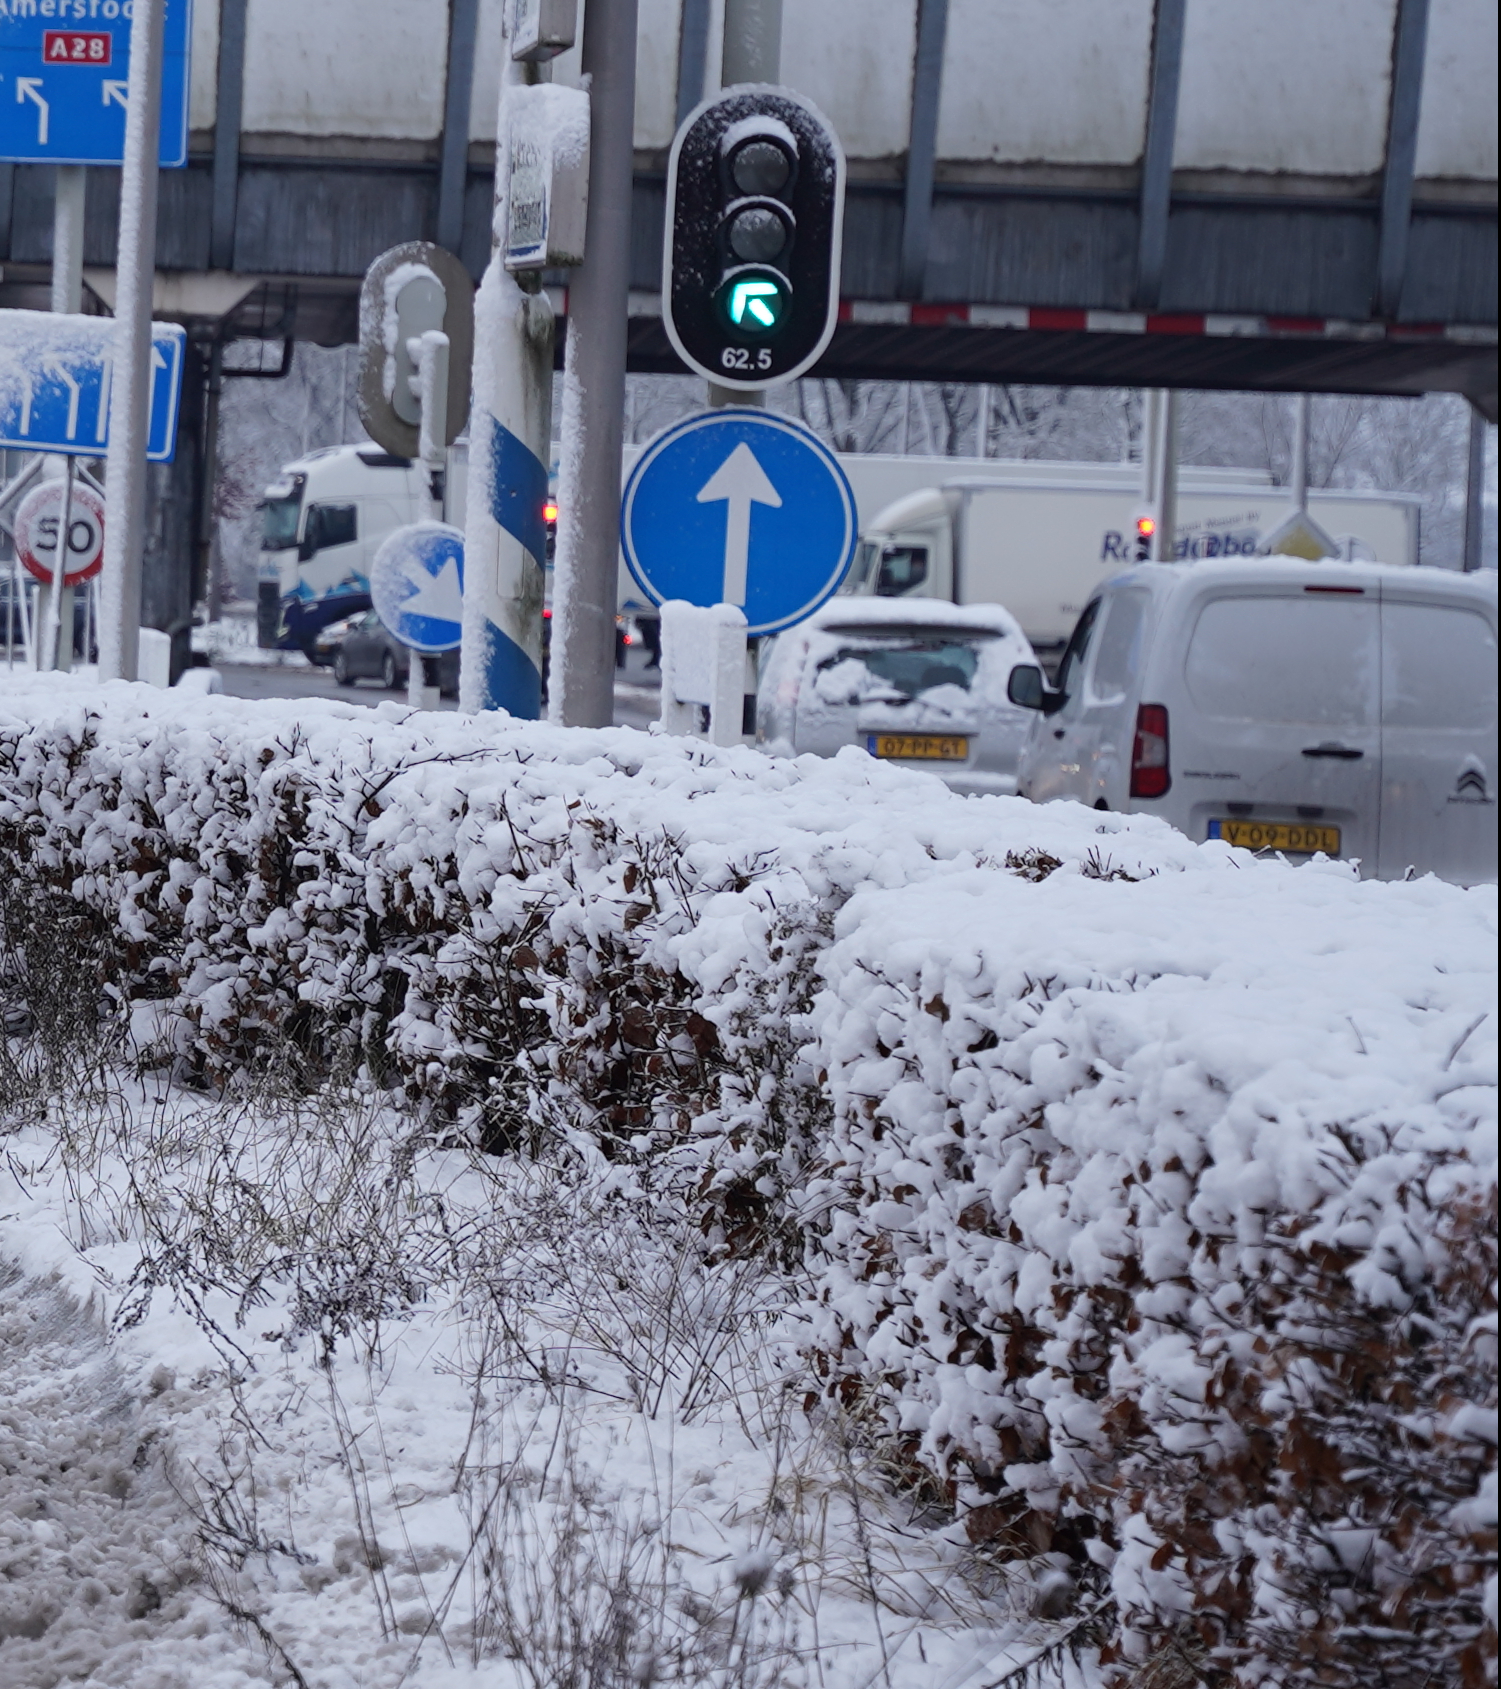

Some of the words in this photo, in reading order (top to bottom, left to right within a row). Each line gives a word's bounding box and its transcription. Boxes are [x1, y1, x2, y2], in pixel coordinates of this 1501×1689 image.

[50, 37, 105, 60] A28
[722, 346, 772, 370] 62.5
[36, 517, 95, 554] 50
